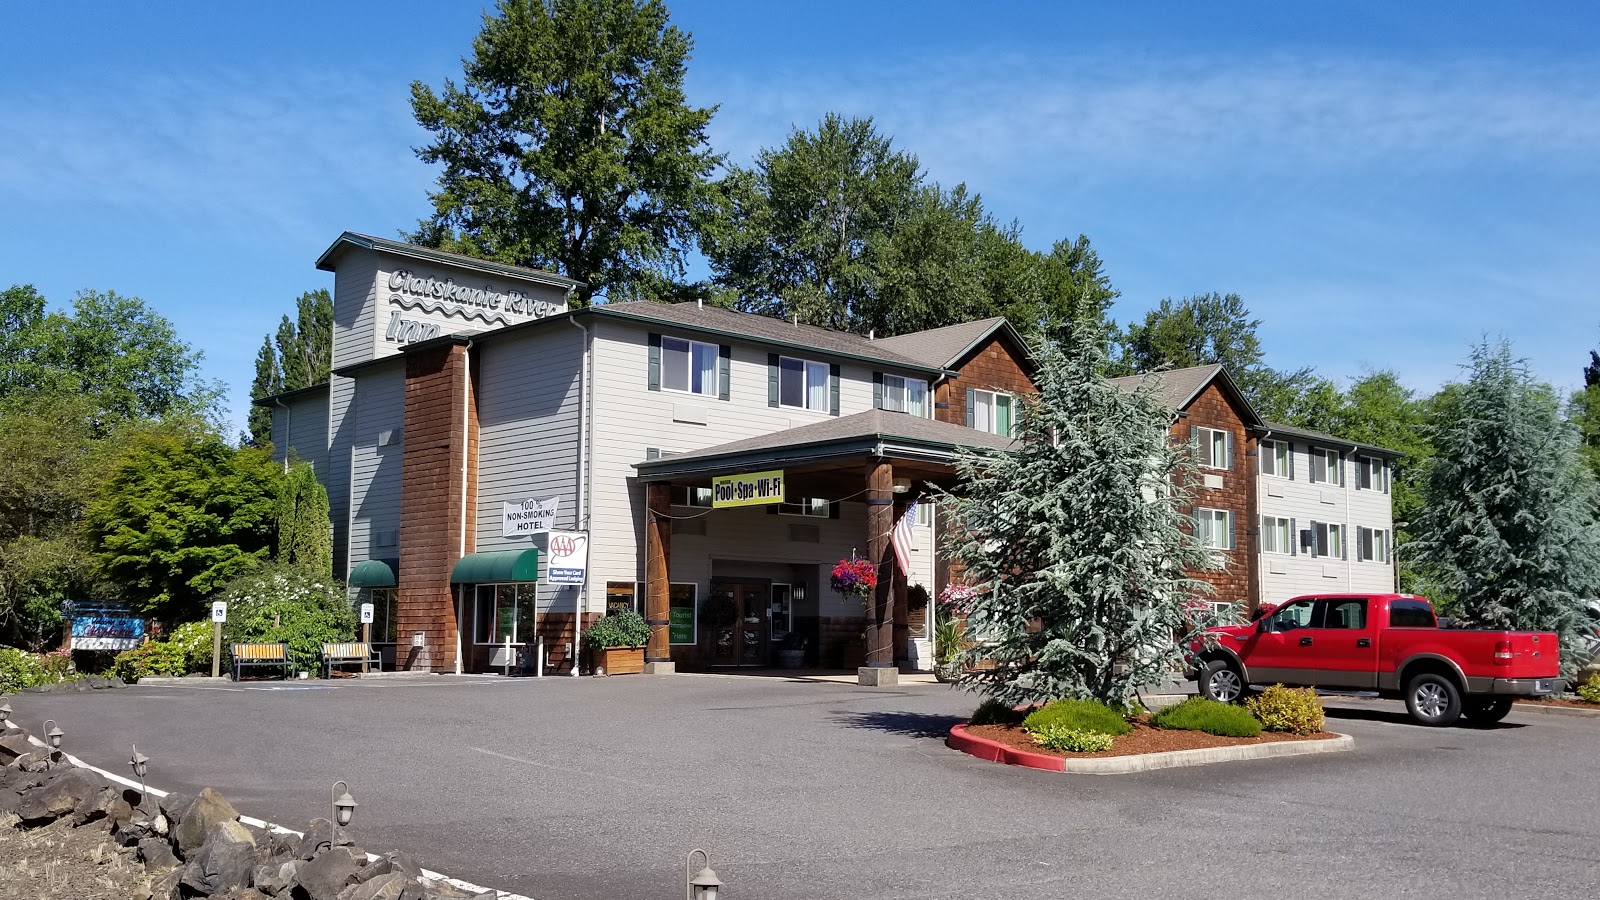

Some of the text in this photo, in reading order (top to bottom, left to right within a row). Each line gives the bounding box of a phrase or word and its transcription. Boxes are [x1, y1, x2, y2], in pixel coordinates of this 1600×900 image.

[388, 268, 557, 318] Clatskanie River
[385, 310, 441, 343] Inn
[715, 477, 781, 502] Pool Spa Wi-Fi
[520, 500, 533, 510] 100
[507, 508, 554, 520] NON-SMOKING
[517, 521, 543, 530] HOTEL
[552, 536, 574, 557] AAA
[672, 611, 692, 619] Tourist
